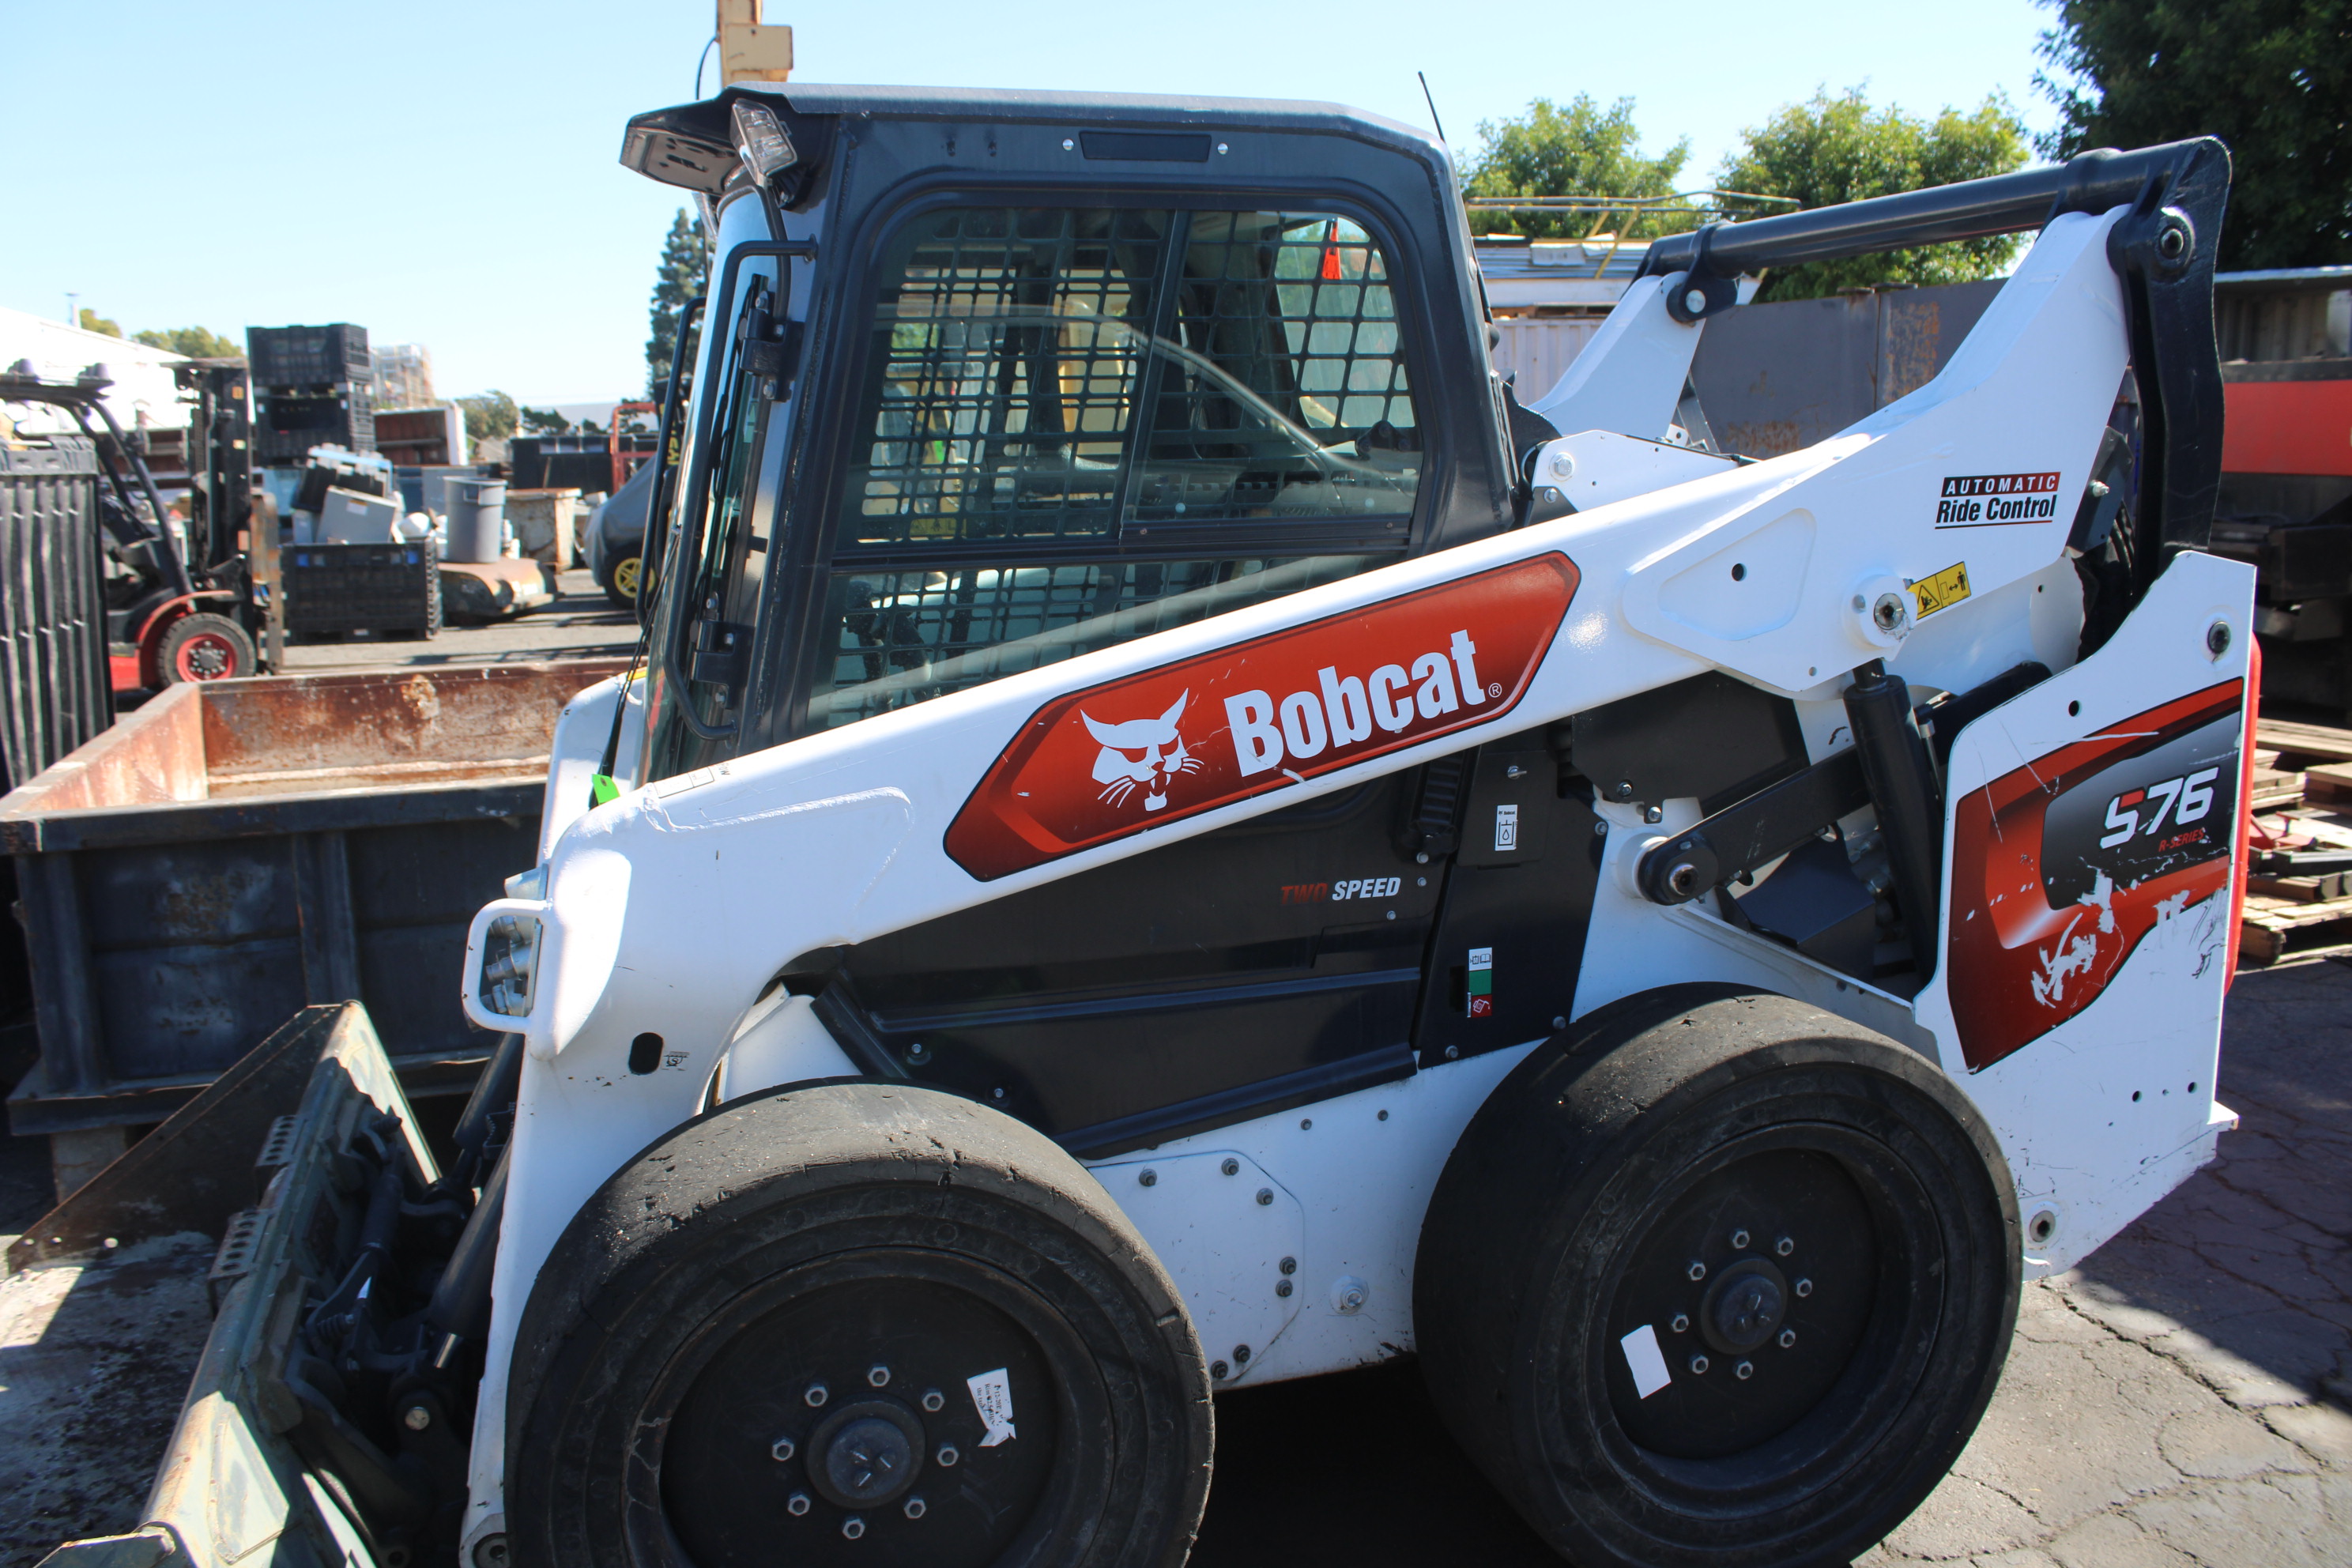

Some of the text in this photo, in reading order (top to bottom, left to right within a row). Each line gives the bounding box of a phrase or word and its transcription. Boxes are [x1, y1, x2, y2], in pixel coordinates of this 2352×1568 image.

[1945, 475, 2056, 495] AUTOMATIC
[1936, 494, 2057, 523] Ride Control
[1223, 628, 1487, 778] Bobcat
[2099, 766, 2220, 850] S76
[2158, 828, 2206, 853] R-SERIES
[1280, 876, 1401, 905] TWO SPEED
